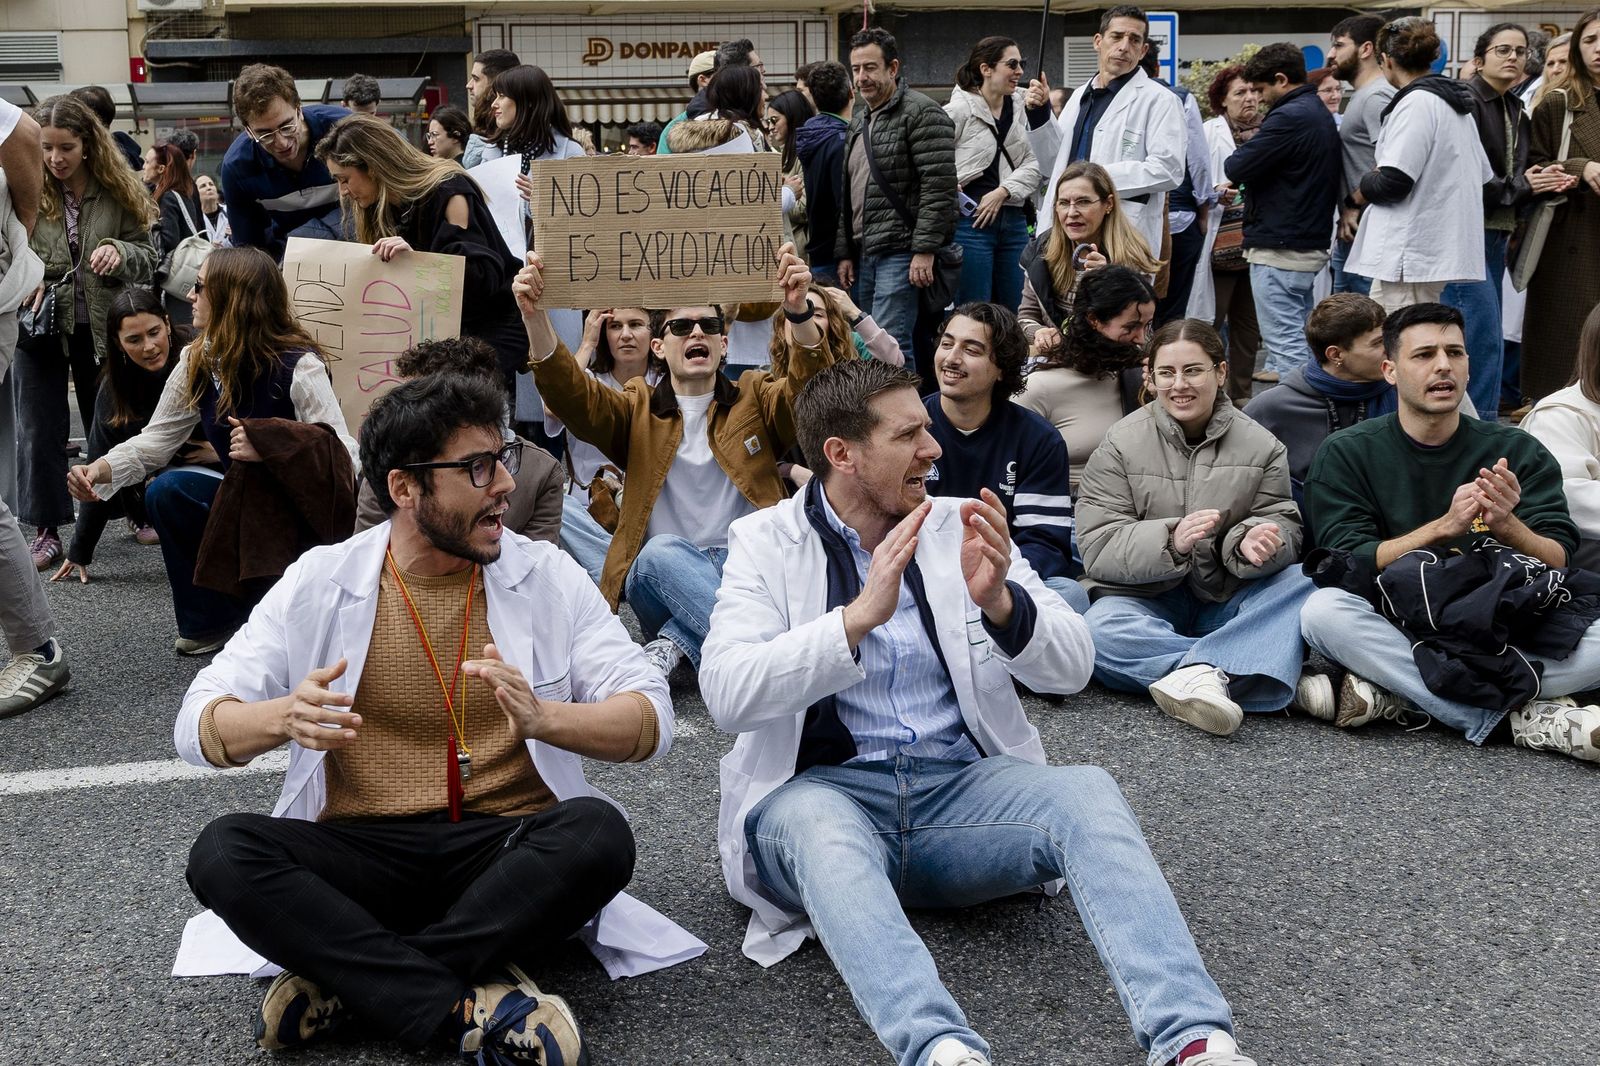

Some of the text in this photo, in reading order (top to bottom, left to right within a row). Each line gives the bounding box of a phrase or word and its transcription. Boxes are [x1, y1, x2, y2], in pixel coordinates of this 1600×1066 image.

[550, 162, 779, 217] NO ES VOCACIÓN
[568, 222, 781, 282] ES EXPLOTACIÓN
[357, 280, 412, 393] SALUD
